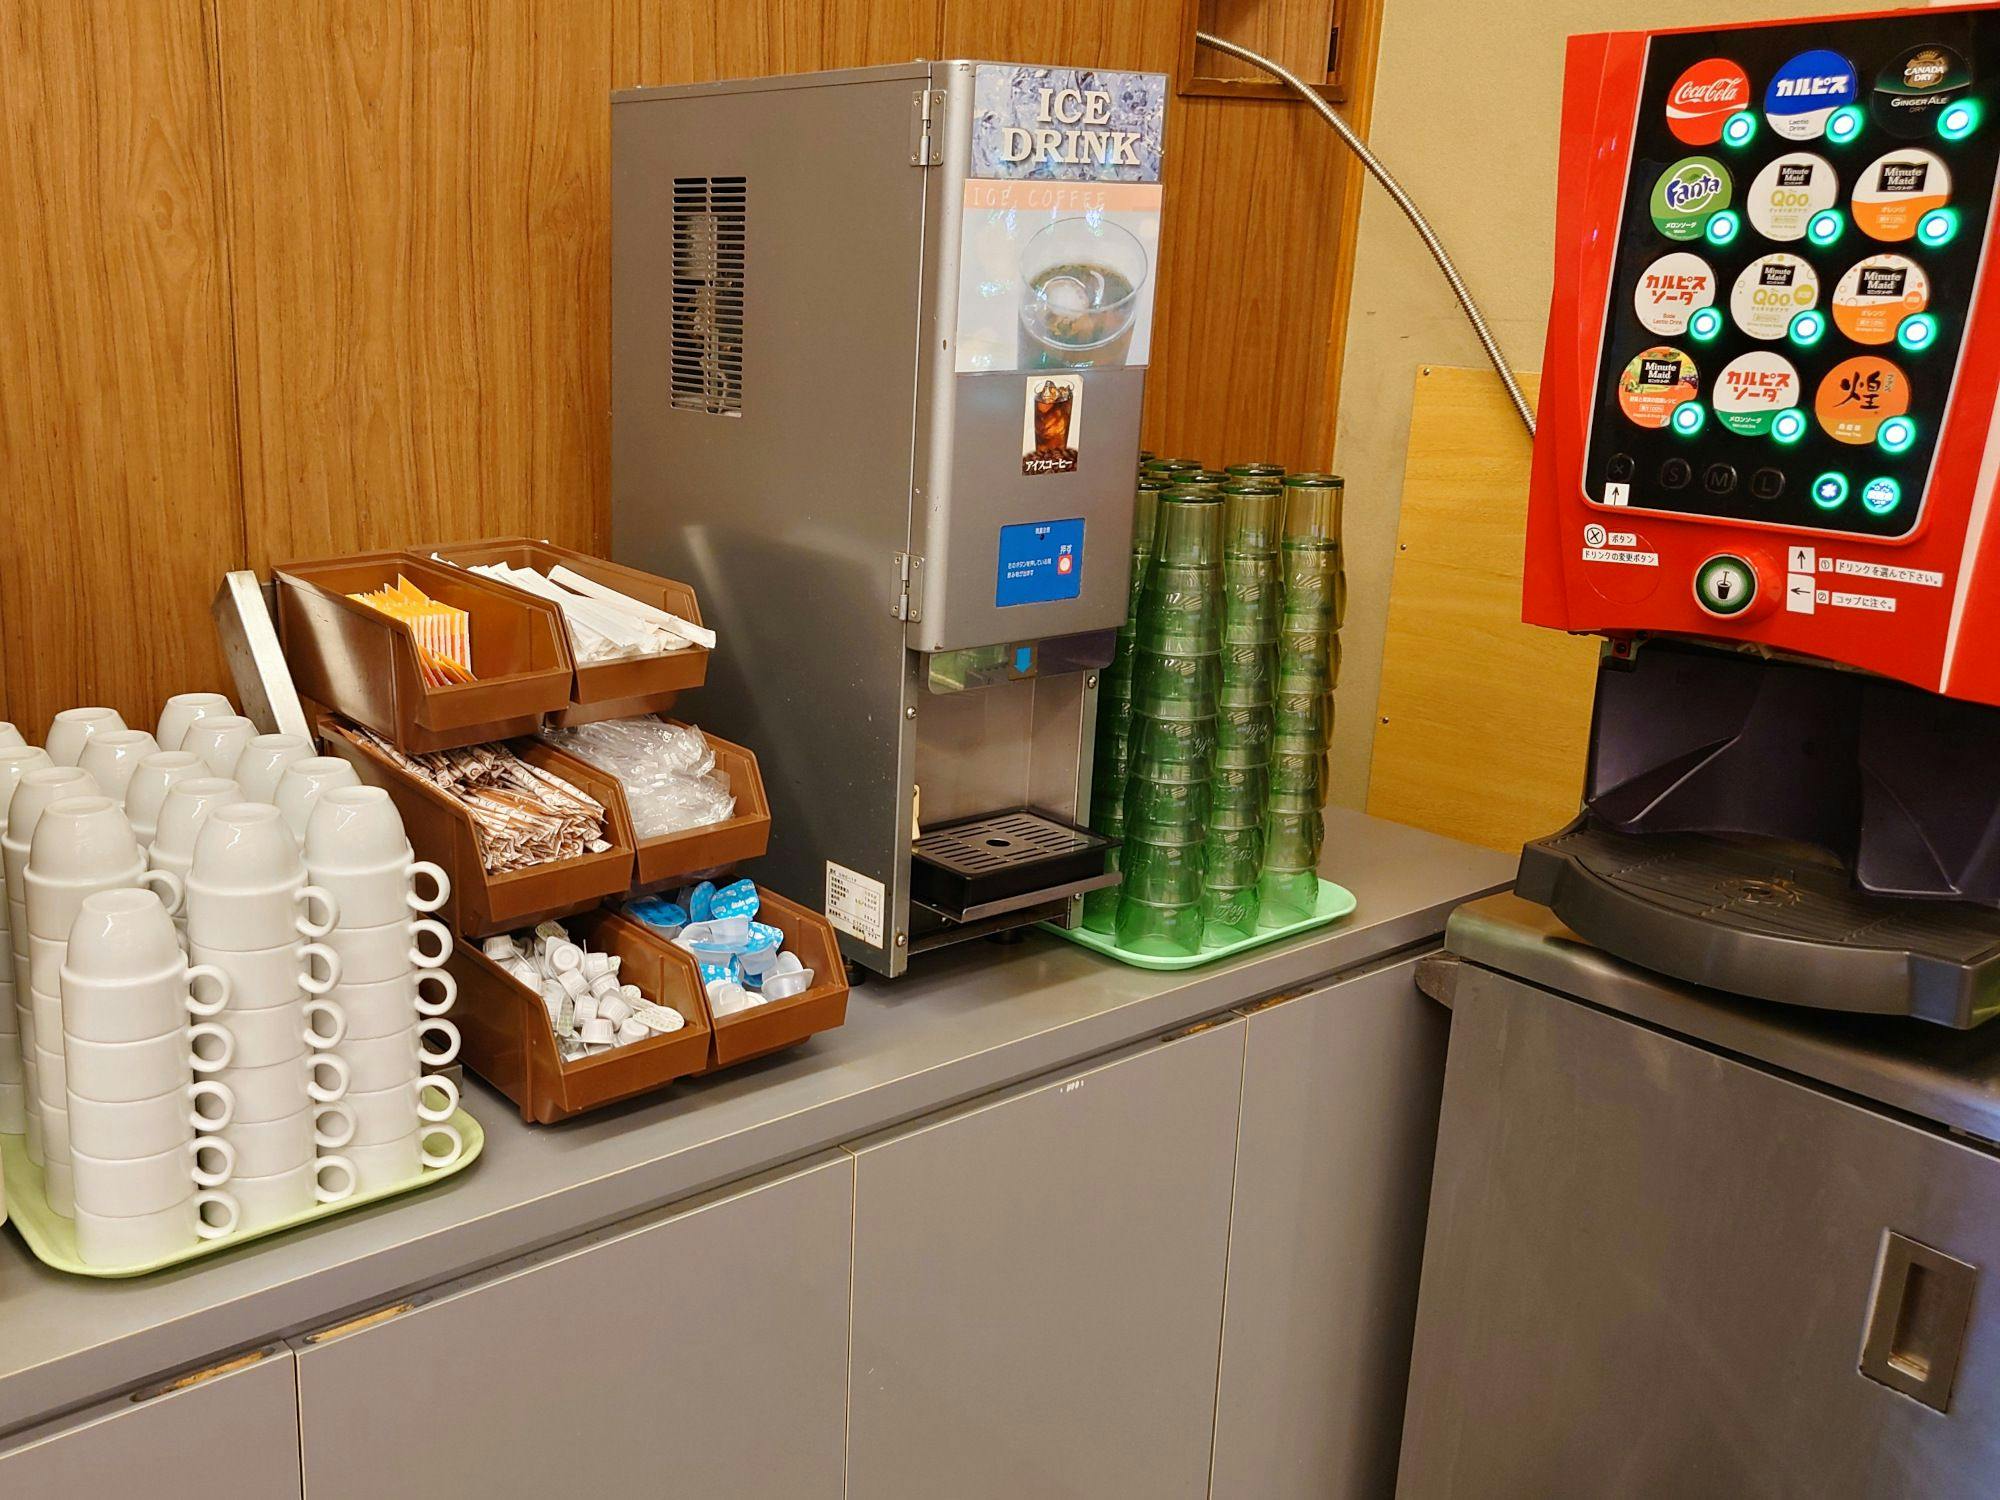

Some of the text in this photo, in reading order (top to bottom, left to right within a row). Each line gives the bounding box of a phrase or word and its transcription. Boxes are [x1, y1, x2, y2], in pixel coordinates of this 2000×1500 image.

[1904, 65, 1946, 76] CANADA
[1914, 73, 1933, 82] DRY
[1775, 75, 1849, 97] カルピス
[1037, 88, 1111, 125] ICE
[1001, 127, 1142, 165] DRINK
[1782, 168, 1809, 176] Minute
[1884, 167, 1923, 177] Minute
[1887, 177, 1917, 185] Maid
[1665, 174, 1722, 209] Fanta
[1771, 190, 1809, 207] Qoo
[1764, 267, 1792, 275] Minute
[1863, 271, 1902, 281] Minute
[1645, 274, 1707, 291] カルピス
[1867, 281, 1895, 289] Maid
[1652, 290, 1699, 306] ソーダ
[1753, 288, 1791, 307] Qoo
[1645, 362, 1677, 372] Minute
[1648, 370, 1671, 379] Maid
[1726, 371, 1791, 387] カルピス
[1733, 386, 1782, 402] ソーダ
[1025, 458, 1073, 471] アイスコーヒー
[1669, 467, 1680, 482] S
[1711, 472, 1729, 487] M
[1762, 478, 1772, 492] L
[1612, 535, 1633, 544] ボタン
[1585, 550, 1655, 563] ドリンクの変更ボタン
[1838, 561, 1938, 584] ドリンクを選んで下さい。
[1835, 595, 1893, 610] コップに注ぐ。
